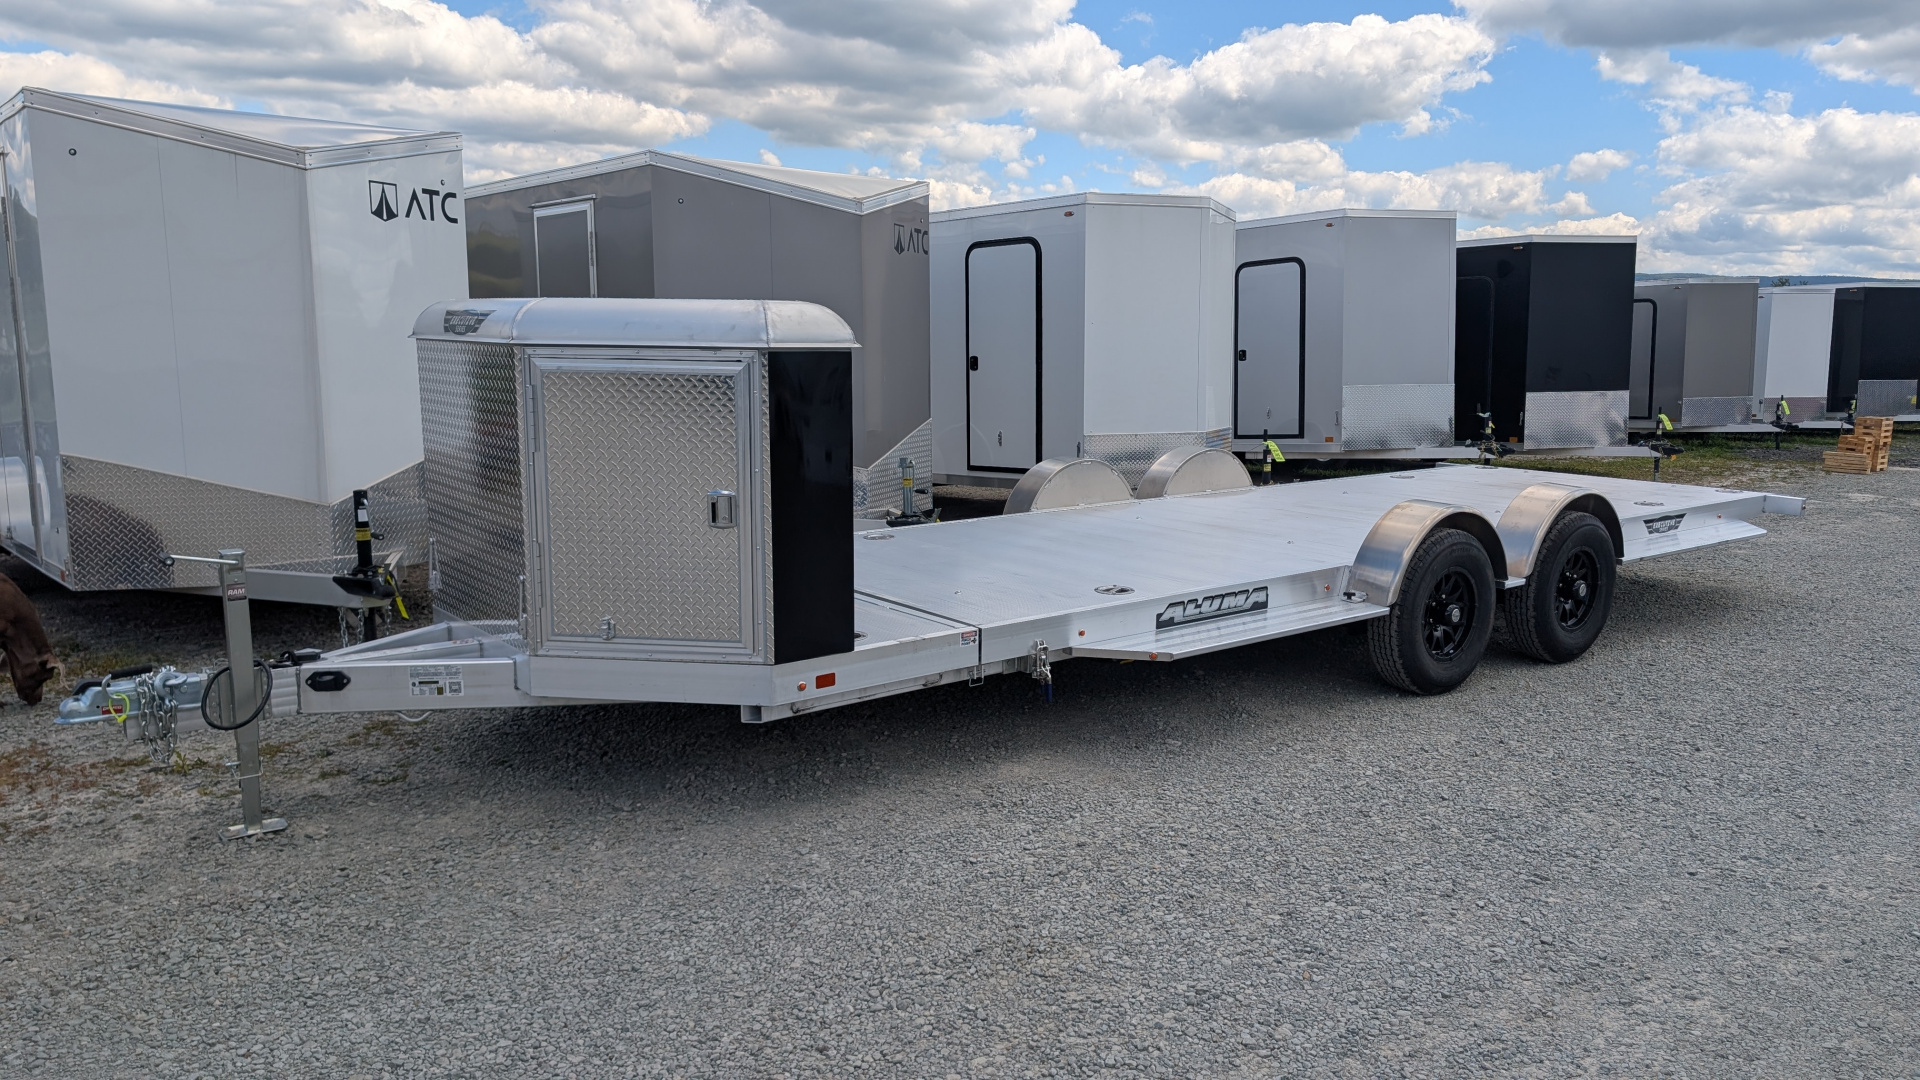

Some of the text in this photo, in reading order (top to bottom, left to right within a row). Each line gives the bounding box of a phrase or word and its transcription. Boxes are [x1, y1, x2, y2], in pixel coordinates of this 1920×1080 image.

[405, 187, 458, 224] ATC
[907, 227, 929, 255] ATC
[1158, 586, 1268, 623] ALUMA
